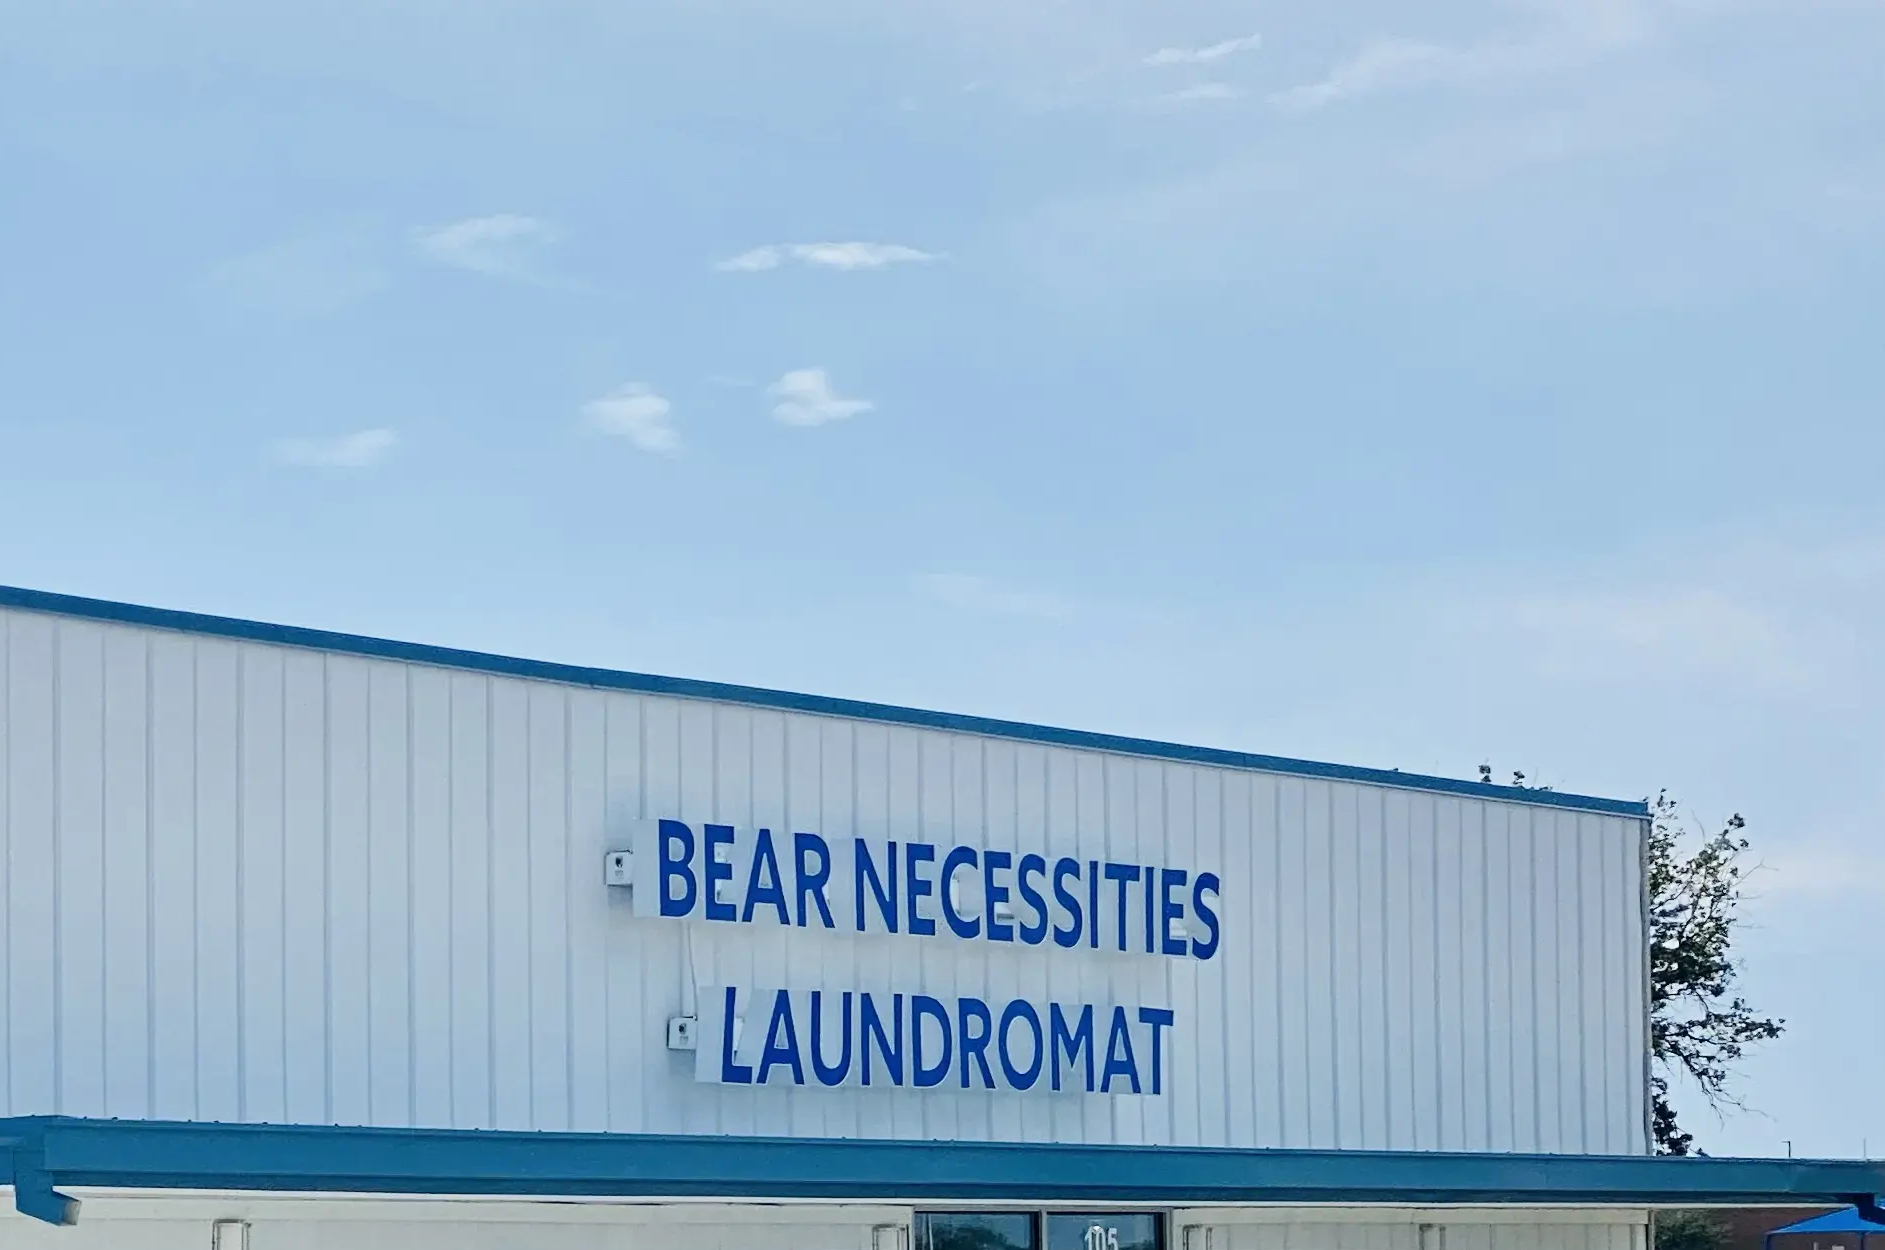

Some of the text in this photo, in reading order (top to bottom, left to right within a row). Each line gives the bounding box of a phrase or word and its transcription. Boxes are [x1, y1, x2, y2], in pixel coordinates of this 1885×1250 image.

[656, 817, 1221, 962] BEAR NECESSITIES
[720, 985, 1175, 1097] LAUNDROMAT
